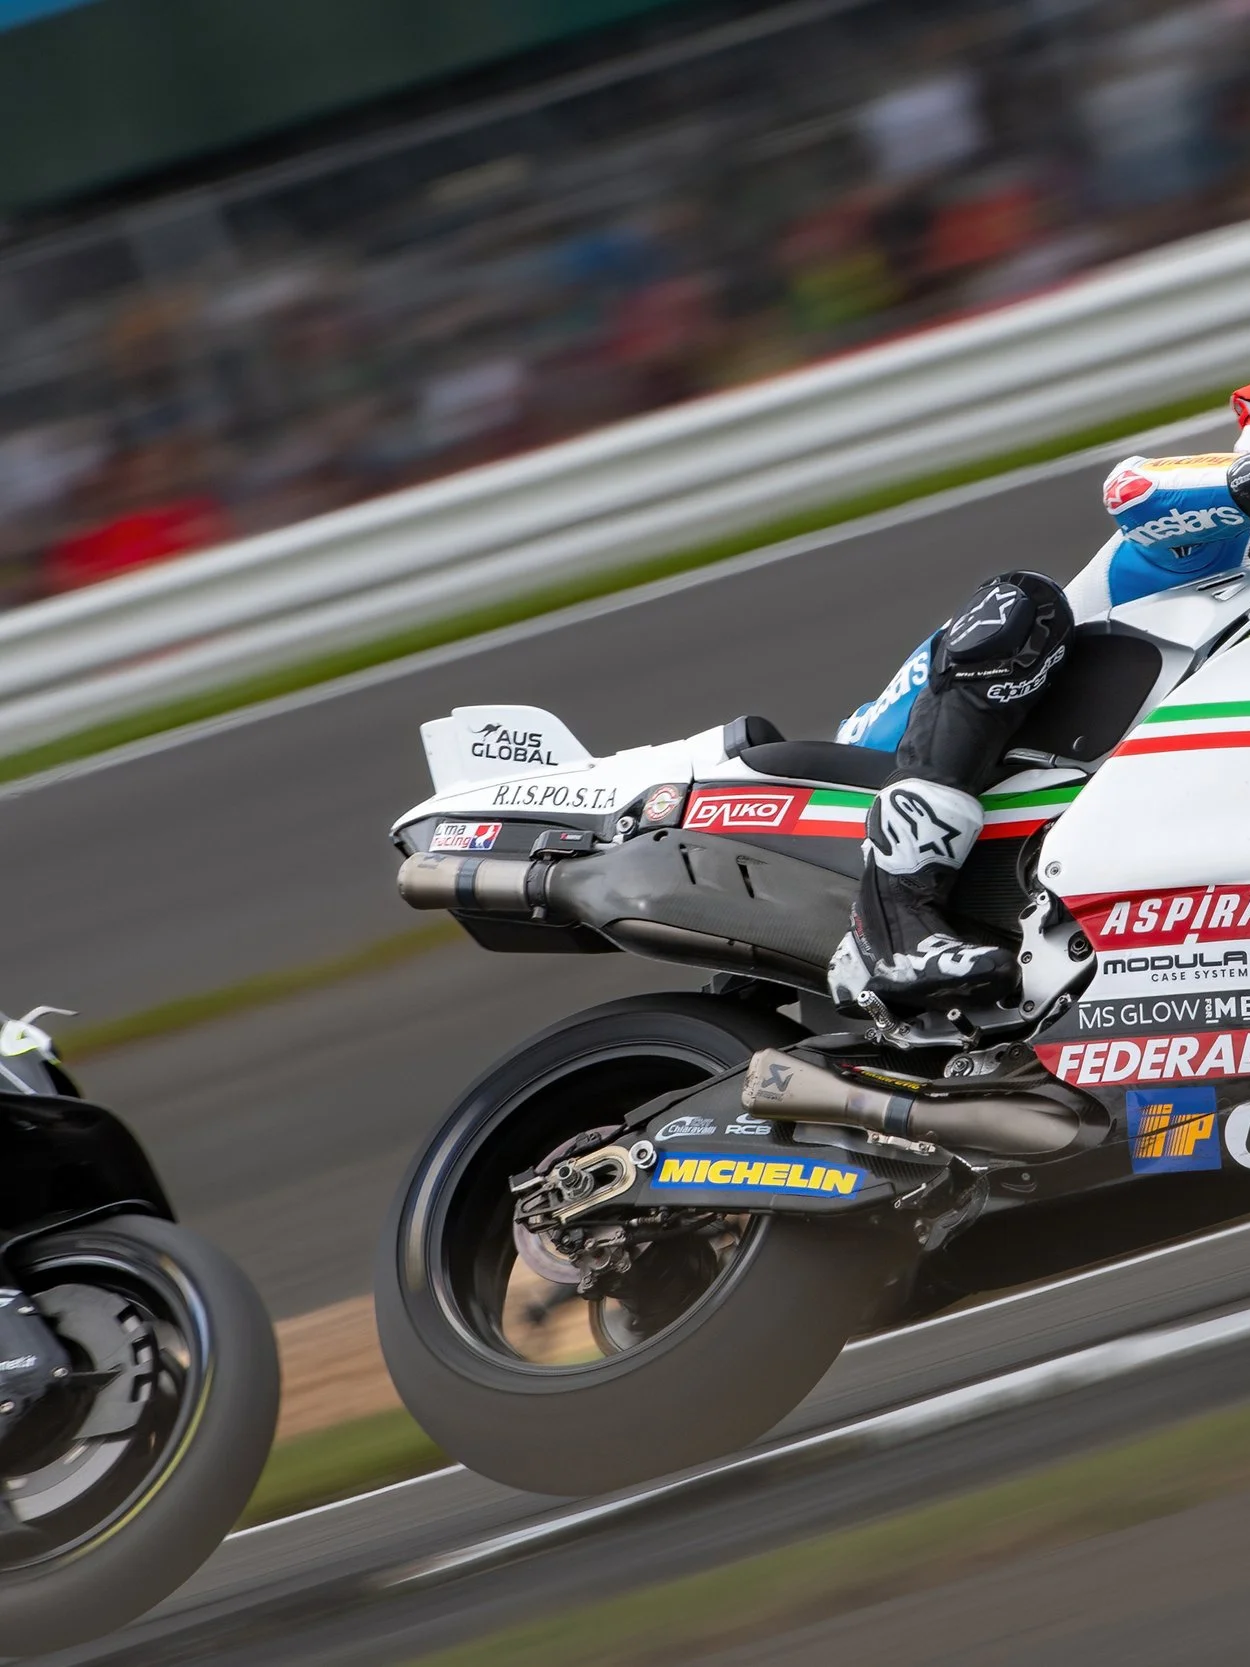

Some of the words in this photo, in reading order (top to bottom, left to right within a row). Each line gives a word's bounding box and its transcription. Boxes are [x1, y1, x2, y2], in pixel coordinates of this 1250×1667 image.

[496, 729, 542, 748] AUS
[471, 742, 559, 766] GLOBAL
[695, 802, 779, 827] DAIKO
[1103, 950, 1248, 975] MODULA
[1151, 971, 1186, 982] CASE
[1194, 968, 1248, 980] SYSTEM
[1079, 1004, 1115, 1029] MS
[1120, 999, 1200, 1025] GLOW
[724, 1124, 771, 1135] RCB
[658, 1159, 858, 1194] MICHELIN
